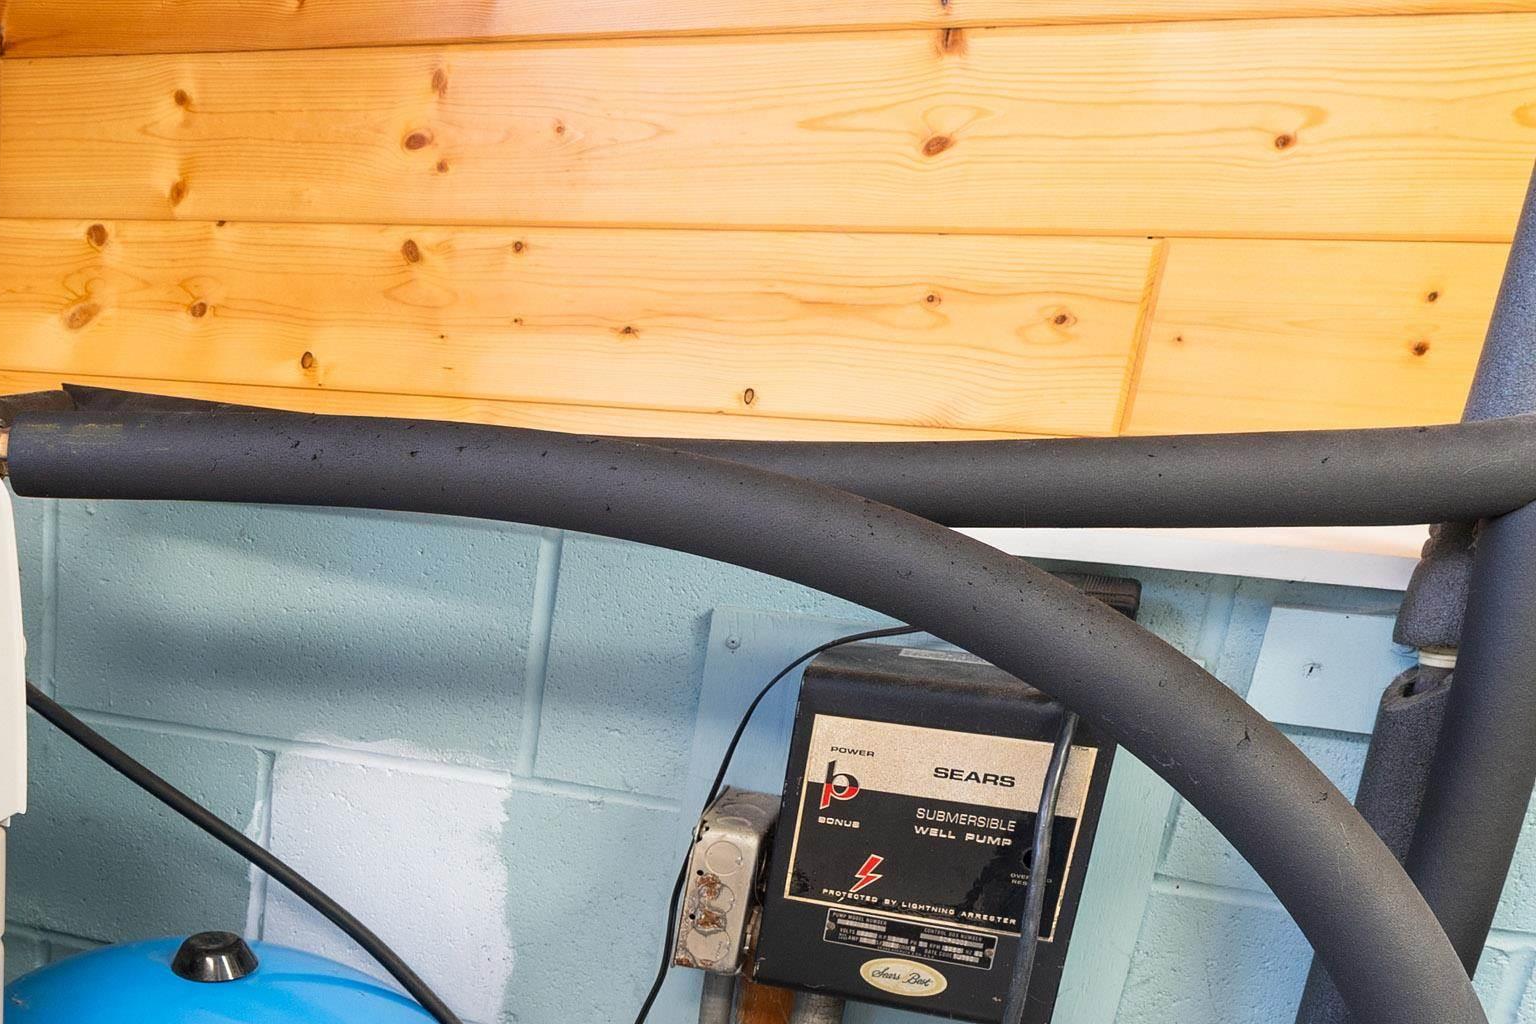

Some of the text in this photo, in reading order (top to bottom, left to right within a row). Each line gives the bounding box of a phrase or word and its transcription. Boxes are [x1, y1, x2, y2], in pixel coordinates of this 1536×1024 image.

[830, 746, 875, 757] POWER
[933, 766, 1016, 788] SEARS
[817, 816, 861, 829] BONUS
[916, 807, 1017, 832] SUBMERSIBLE
[914, 825, 1013, 847] WELL PUMP
[1010, 872, 1053, 884] OVERD
[822, 888, 1017, 926] PROTECTED BY LIGHTNING ARRESTER
[871, 966, 932, 987] Sears Best
